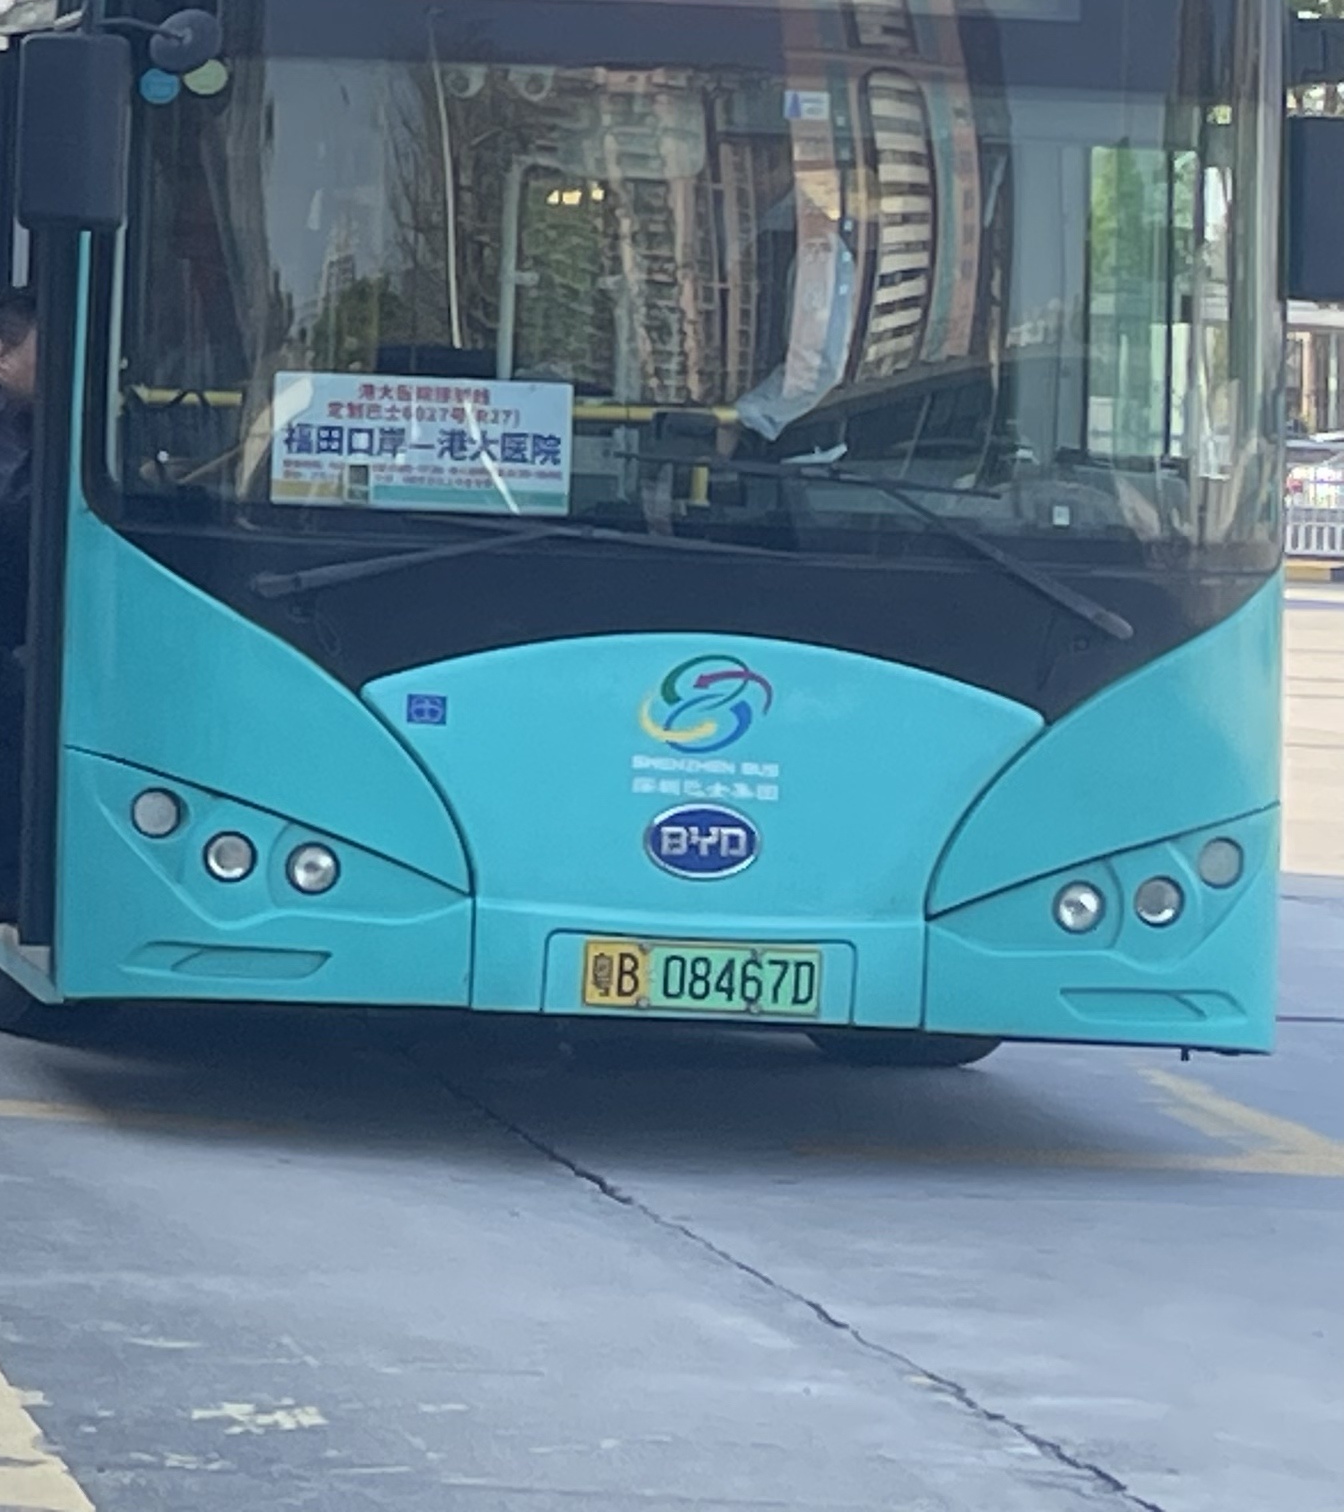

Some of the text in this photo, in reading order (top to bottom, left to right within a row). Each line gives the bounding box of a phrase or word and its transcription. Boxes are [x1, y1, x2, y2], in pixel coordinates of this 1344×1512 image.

[740, 760, 780, 777] BUS
[661, 825, 748, 858] BYD
[662, 954, 816, 1005] 08467D
